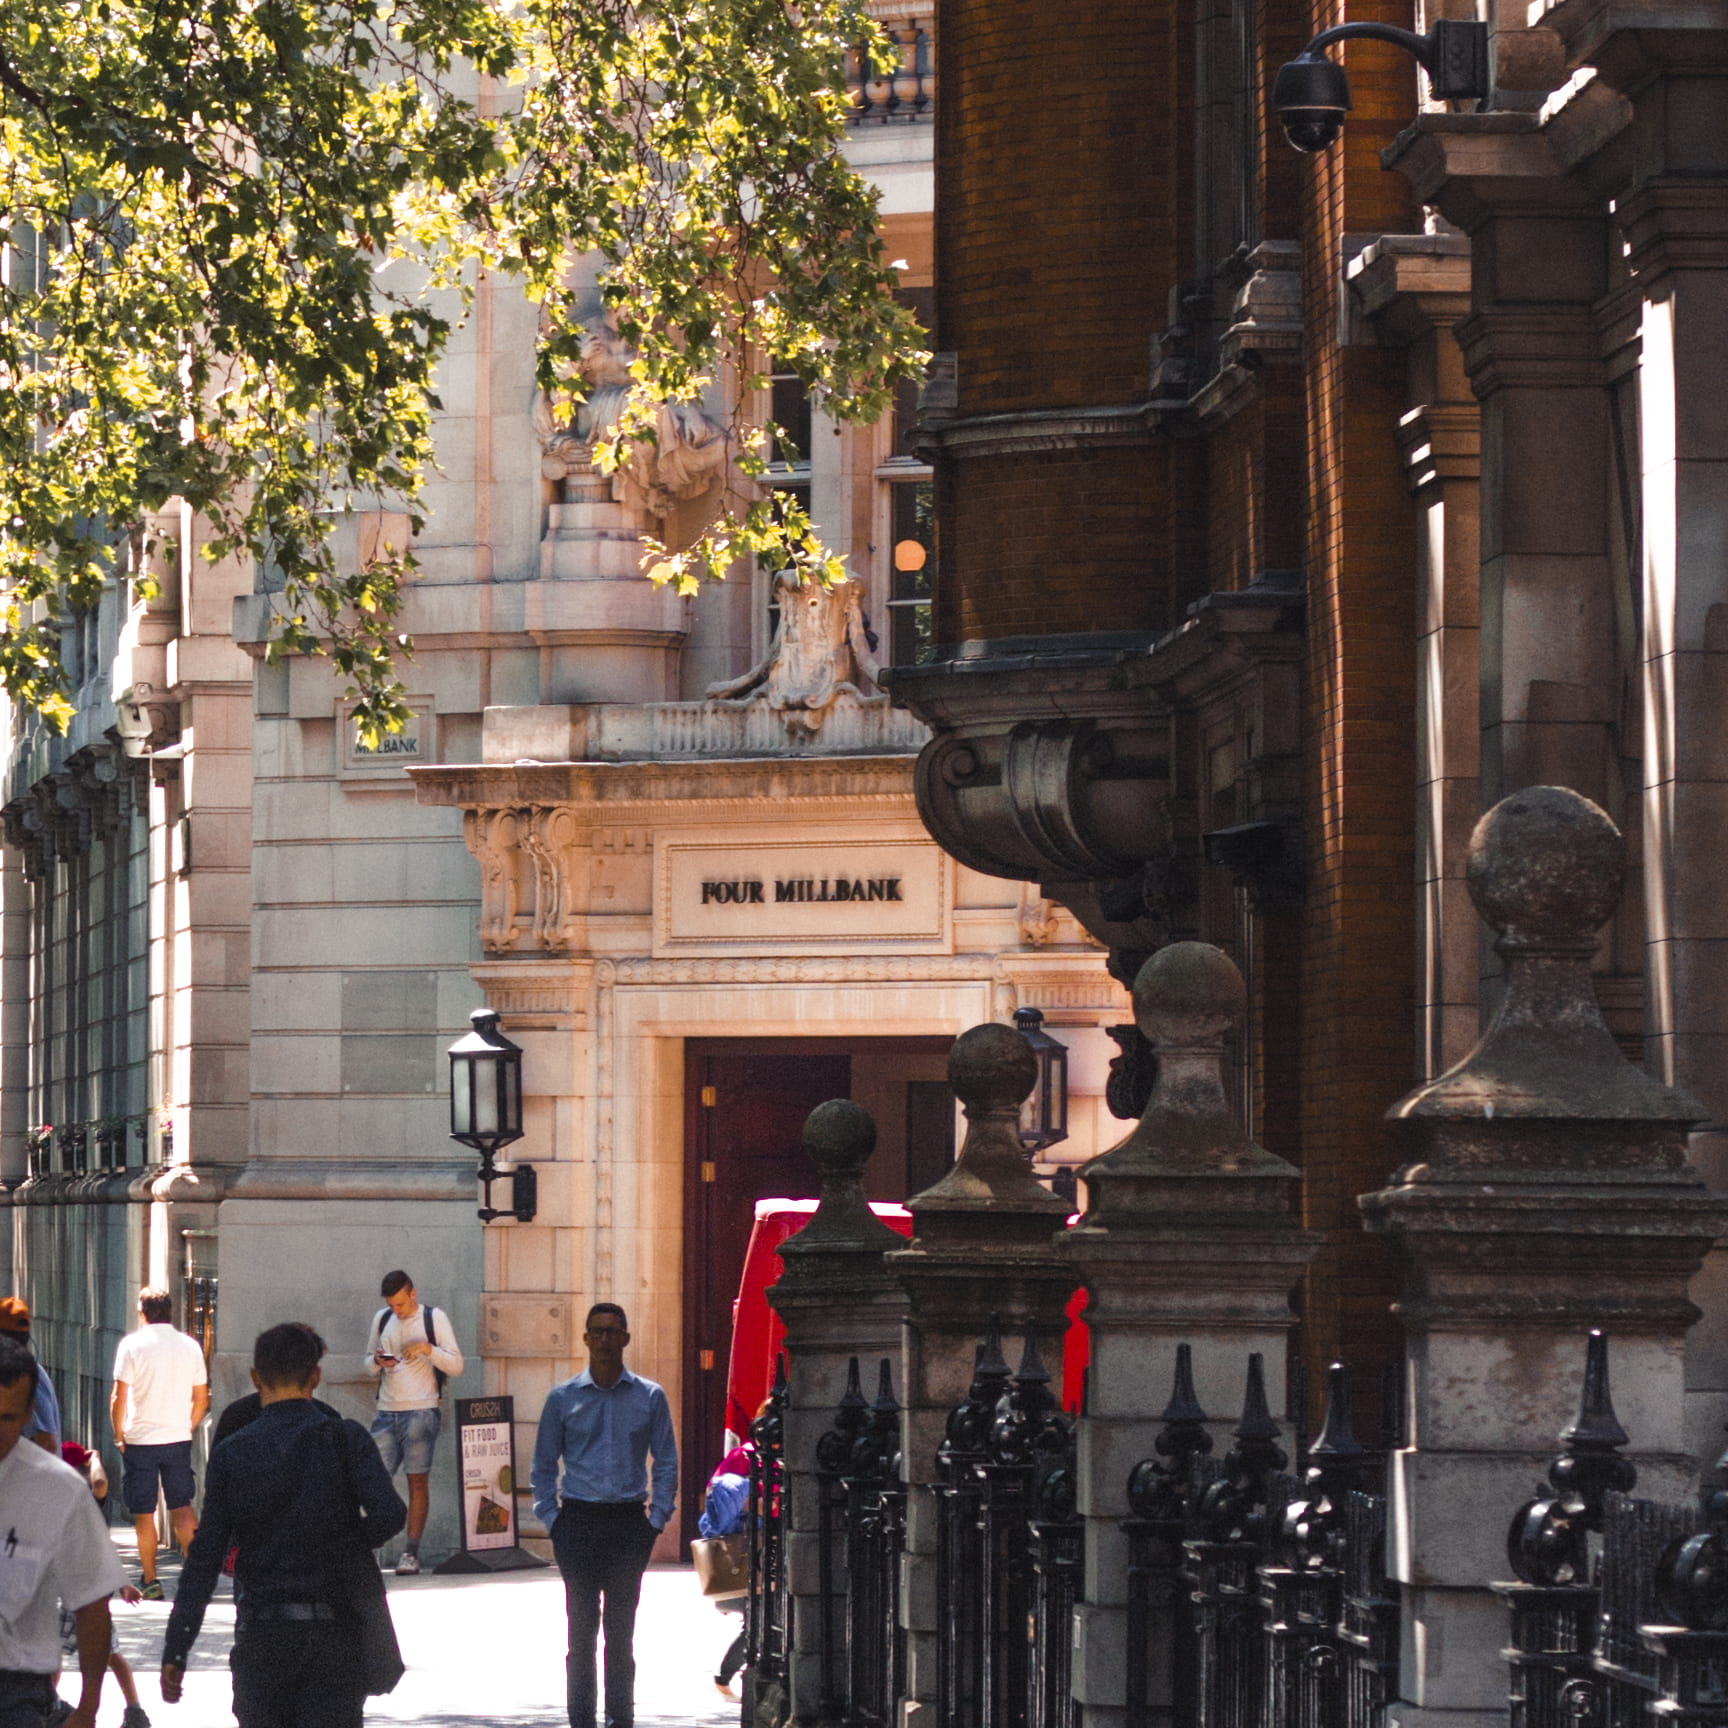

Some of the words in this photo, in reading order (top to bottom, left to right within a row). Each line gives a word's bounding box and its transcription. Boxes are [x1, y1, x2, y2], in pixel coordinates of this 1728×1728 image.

[700, 880, 765, 904] FOUR
[774, 878, 903, 902] MILLBANK
[477, 1427, 497, 1441] FOOD
